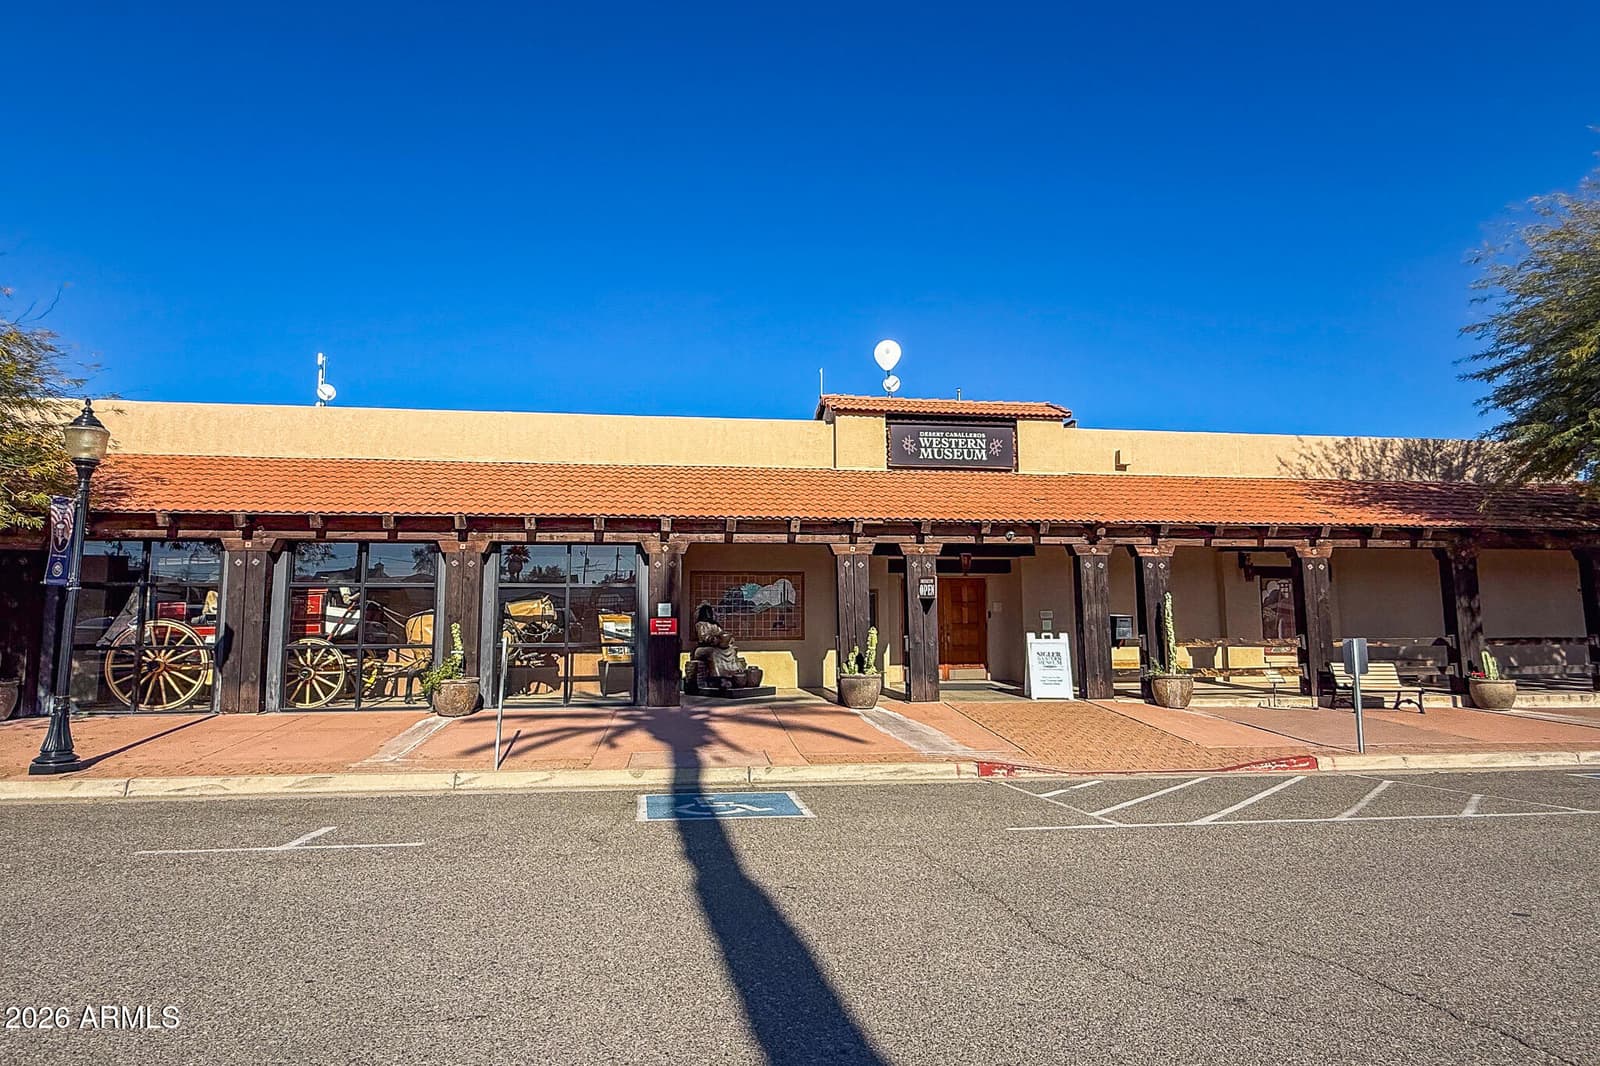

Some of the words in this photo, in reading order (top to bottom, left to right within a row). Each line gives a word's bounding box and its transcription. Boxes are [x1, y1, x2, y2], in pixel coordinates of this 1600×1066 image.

[919, 437, 987, 449] WESTERN
[919, 448, 988, 460] MUSEUM
[920, 584, 935, 596] OPEN
